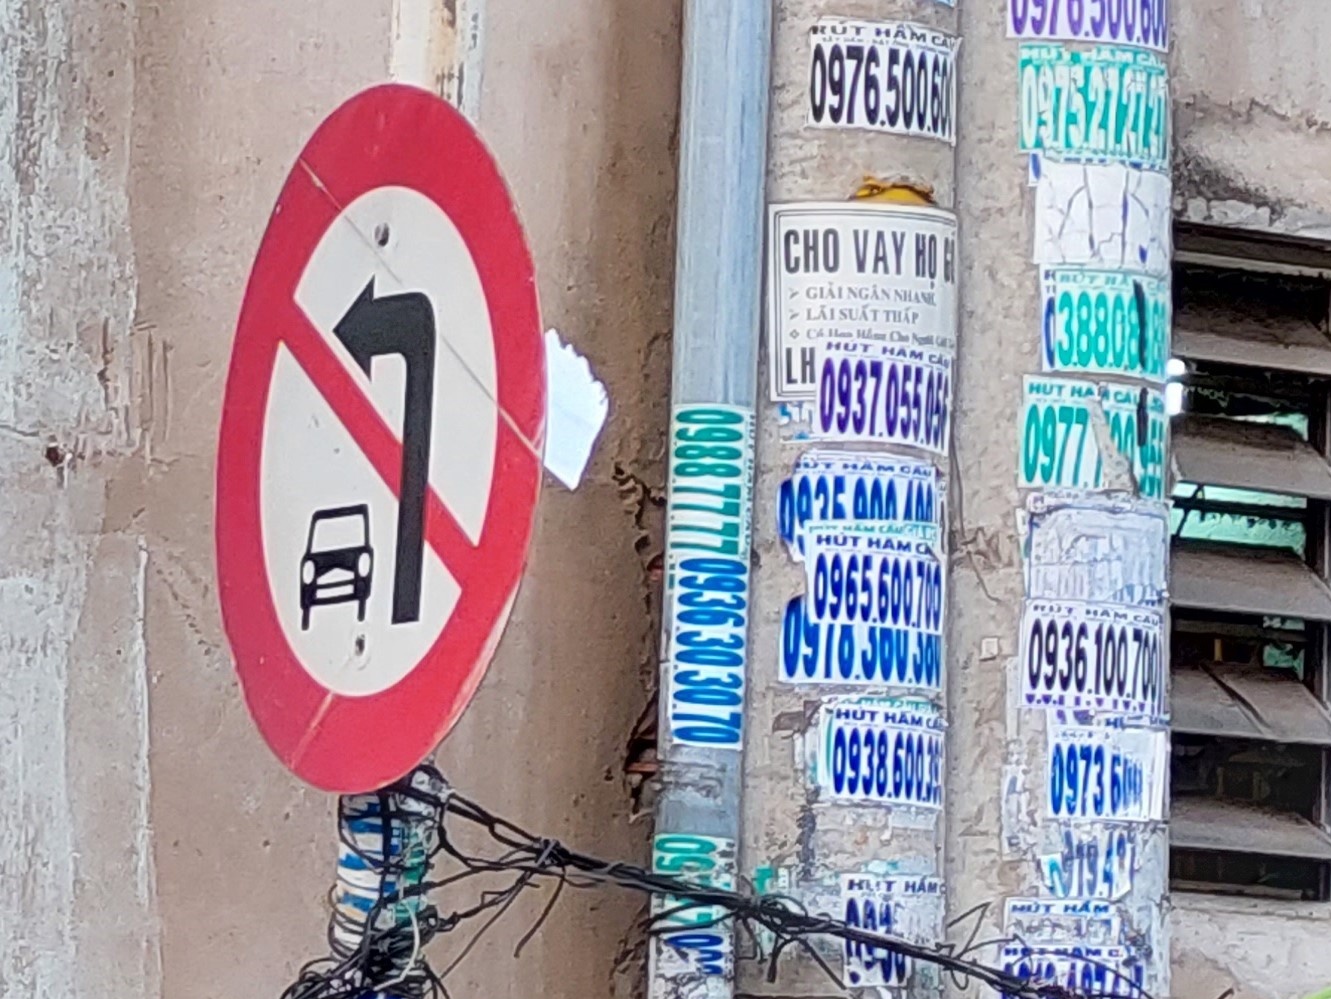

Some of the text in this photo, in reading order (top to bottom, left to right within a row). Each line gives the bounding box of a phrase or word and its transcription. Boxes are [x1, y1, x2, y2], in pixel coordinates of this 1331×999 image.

[784, 228, 840, 274] CHO
[853, 229, 906, 275] VAY
[814, 553, 942, 631] 0965.600.700
